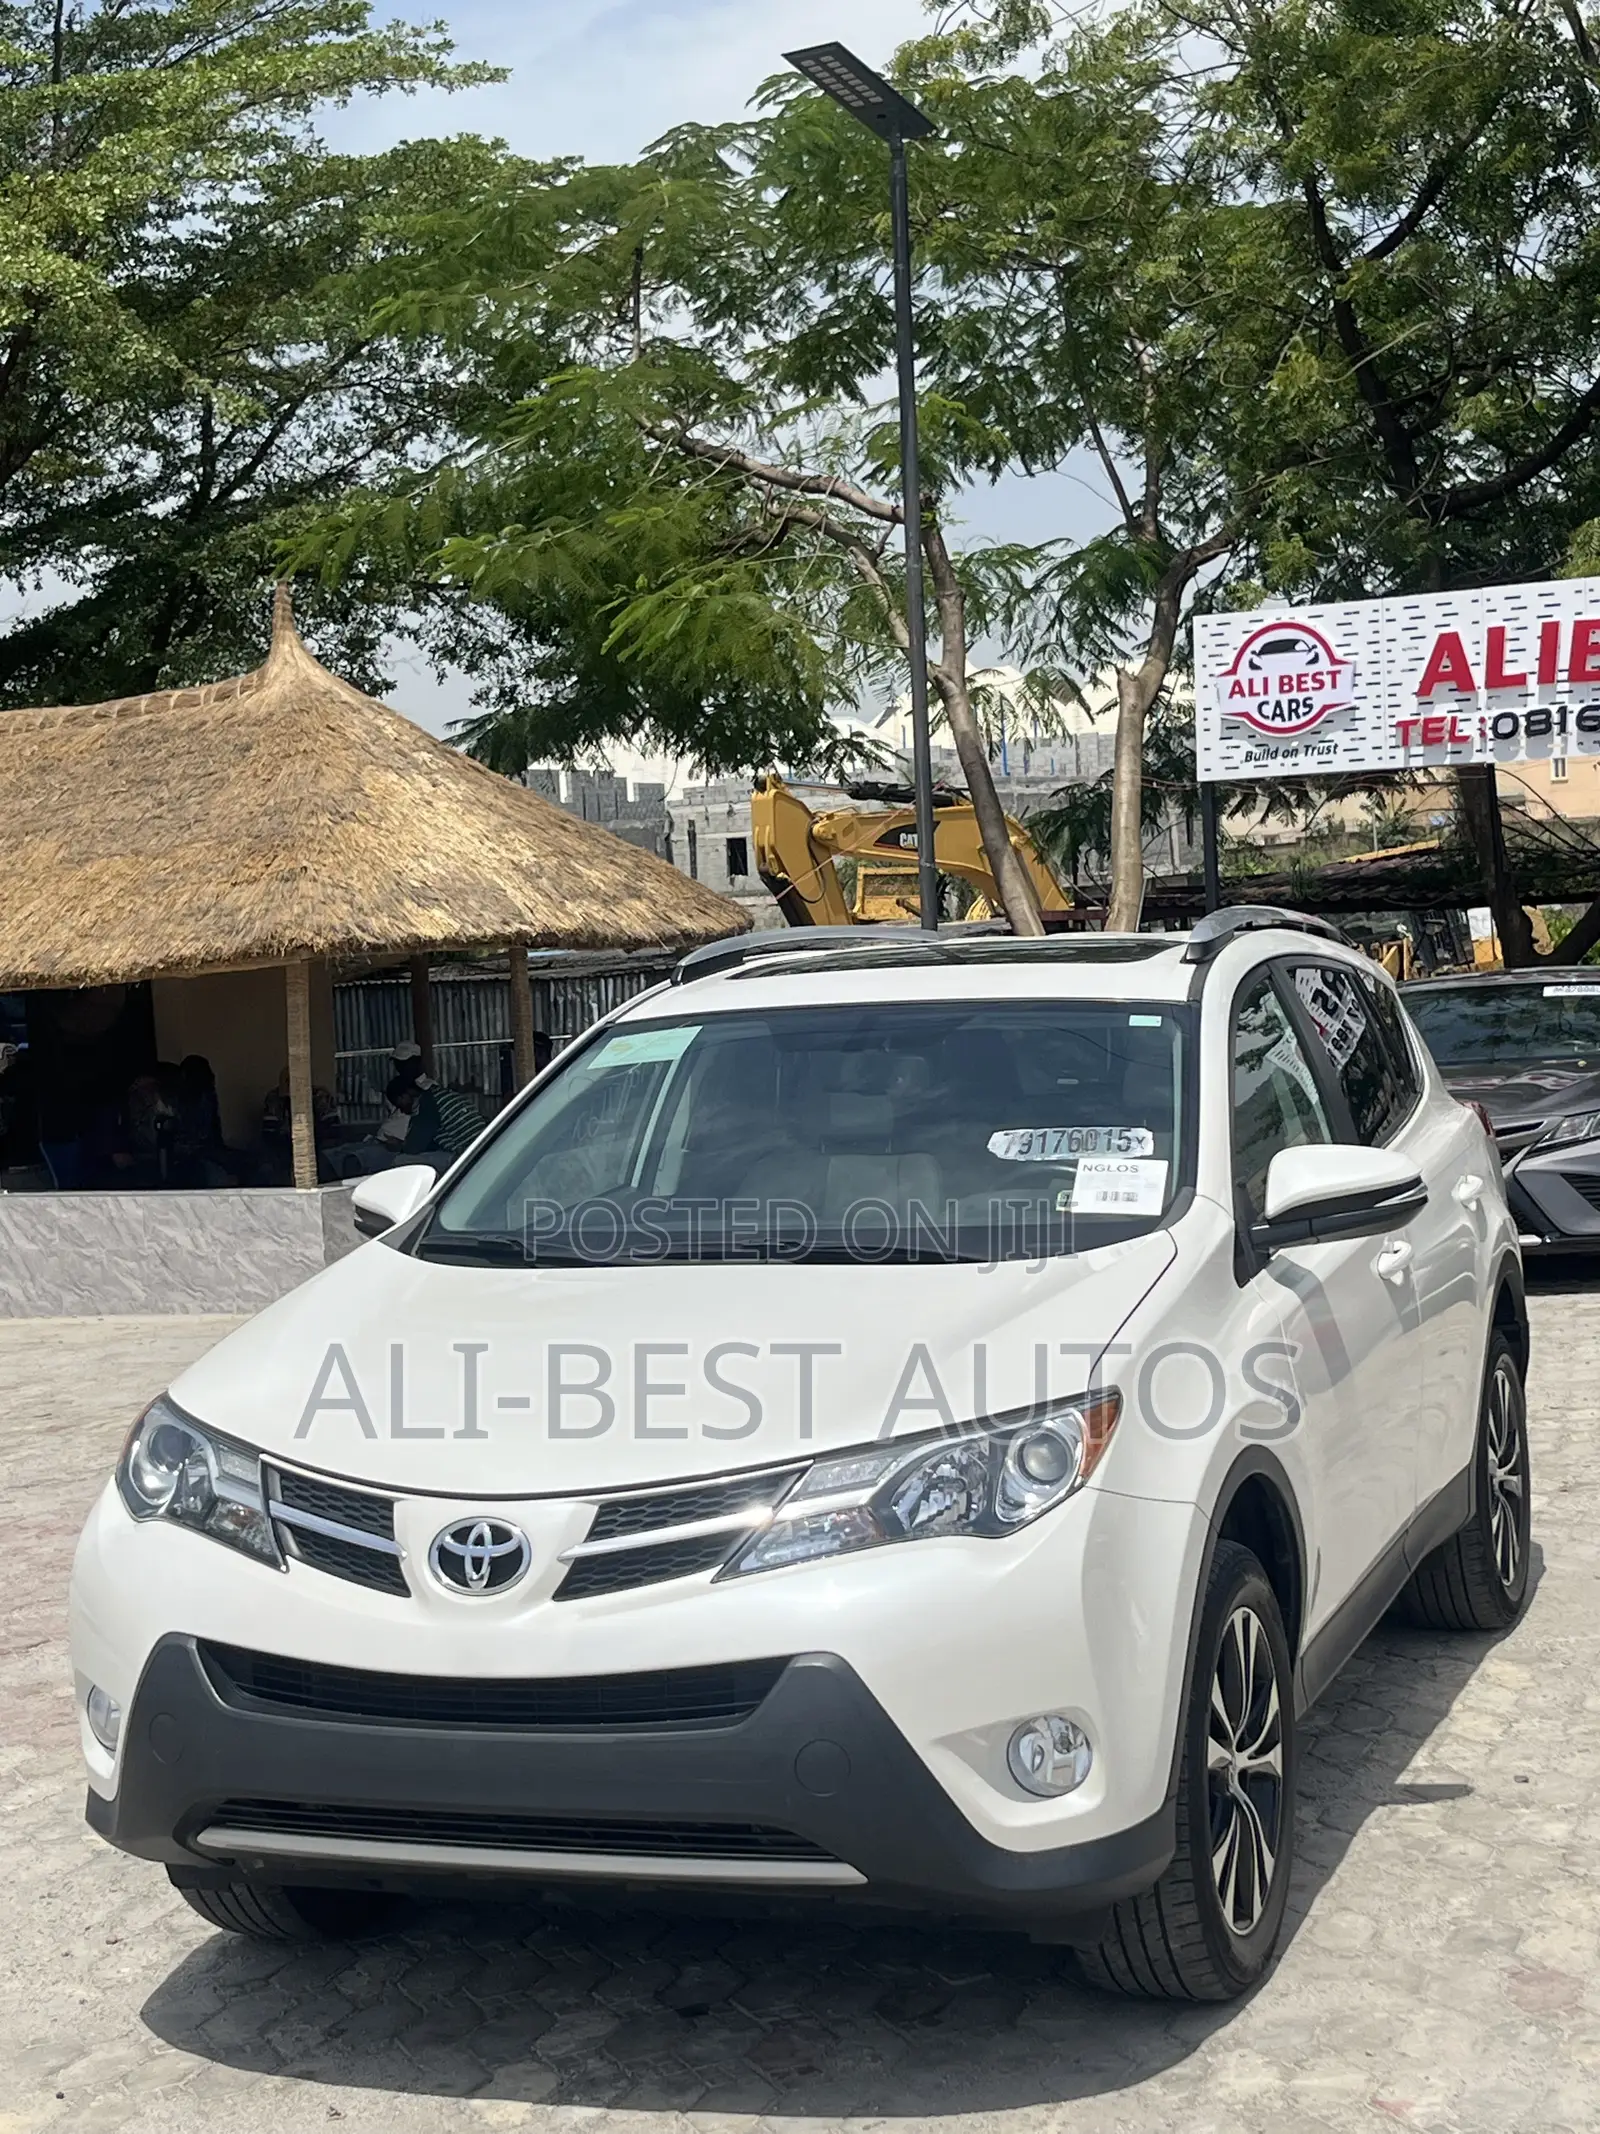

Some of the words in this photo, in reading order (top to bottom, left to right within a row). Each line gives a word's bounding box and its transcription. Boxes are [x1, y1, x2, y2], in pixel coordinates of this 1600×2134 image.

[1228, 676, 1269, 699] ALI
[1278, 670, 1342, 694] BEST
[1257, 697, 1314, 722] CARS
[1244, 746, 1279, 763] Build
[1281, 747, 1299, 759] on
[1304, 743, 1339, 757] Trust
